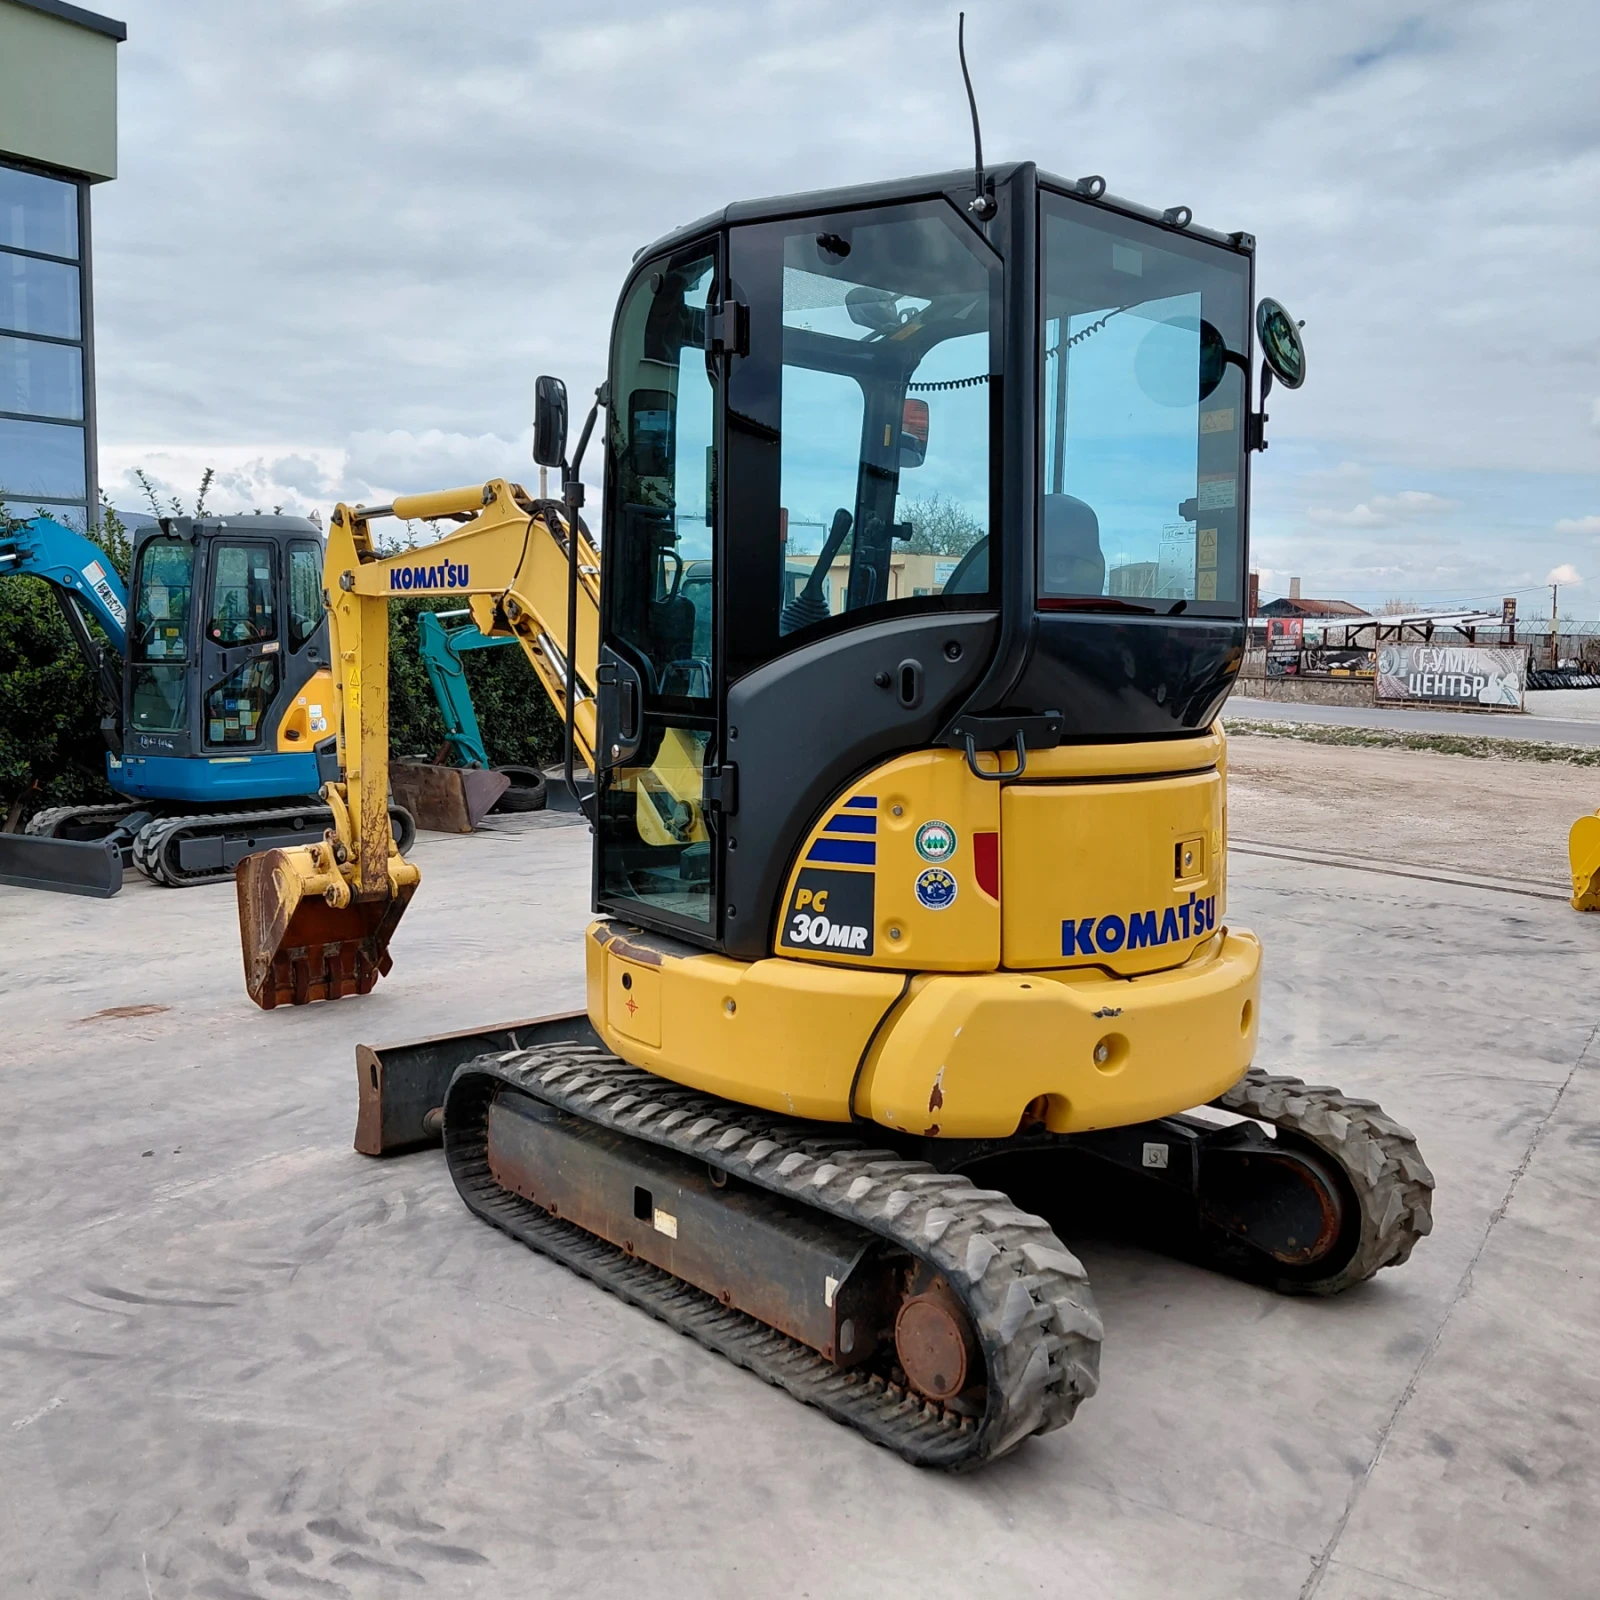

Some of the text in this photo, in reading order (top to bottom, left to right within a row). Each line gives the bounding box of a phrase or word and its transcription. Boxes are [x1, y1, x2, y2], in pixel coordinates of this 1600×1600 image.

[390, 559, 469, 590] KOMATSU
[1418, 647, 1480, 674] ГУМИ
[1408, 673, 1485, 698] ЦЕНТЪР
[795, 888, 828, 912] PC
[789, 913, 868, 949] 30MR
[1061, 891, 1215, 957] KOMATSU
